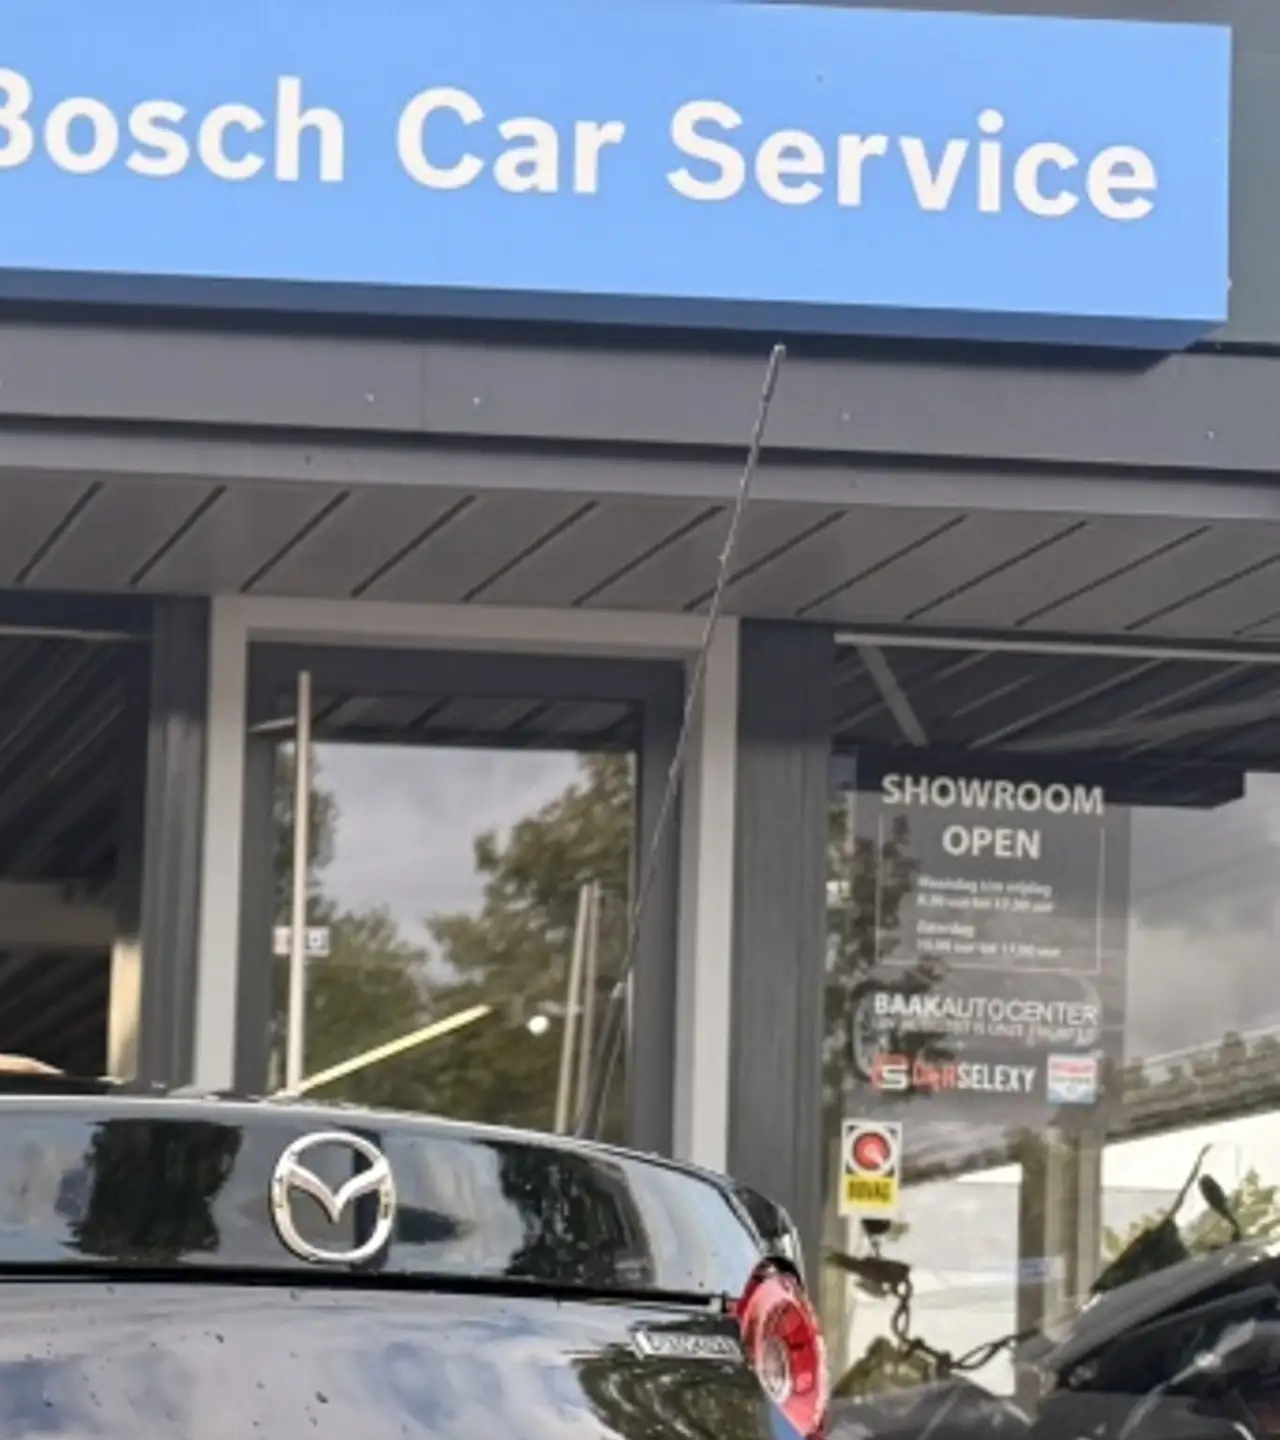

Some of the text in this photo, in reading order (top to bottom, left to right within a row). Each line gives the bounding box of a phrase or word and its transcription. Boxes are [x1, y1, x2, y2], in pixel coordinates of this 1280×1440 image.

[397, 87, 626, 194] Car
[666, 100, 1158, 220] Service
[880, 773, 1105, 816] SHOWROOM
[941, 825, 1041, 860] OPEN
